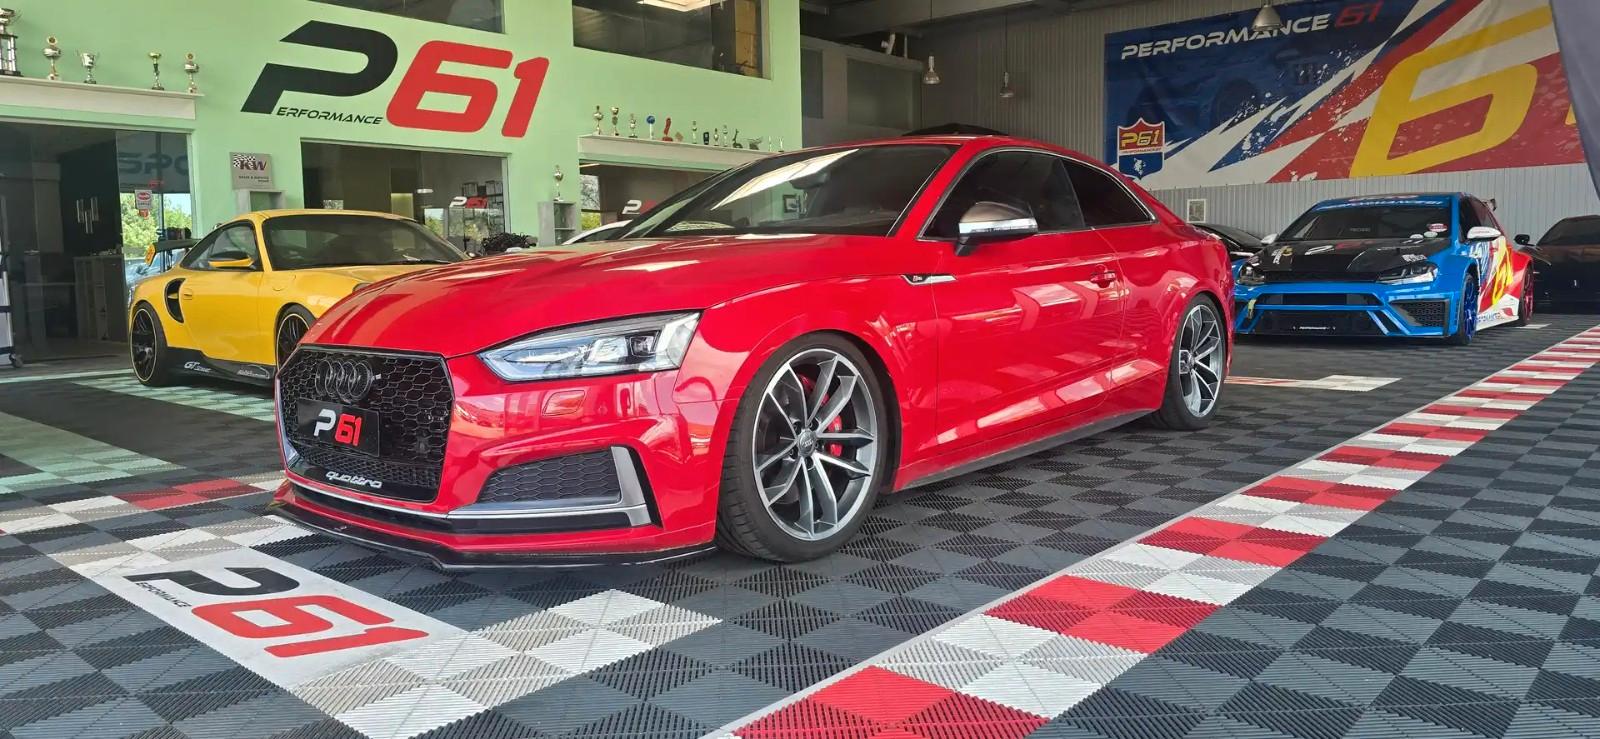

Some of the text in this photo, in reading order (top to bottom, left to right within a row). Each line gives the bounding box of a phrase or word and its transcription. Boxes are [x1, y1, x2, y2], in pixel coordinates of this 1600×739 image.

[1121, 2, 1384, 60] PERFORMANCE 61
[240, 20, 550, 138] P61
[1121, 130, 1160, 148] P61
[239, 159, 267, 171] KW
[313, 408, 363, 447] P61
[325, 470, 383, 489] quattro
[122, 567, 430, 658] P61
